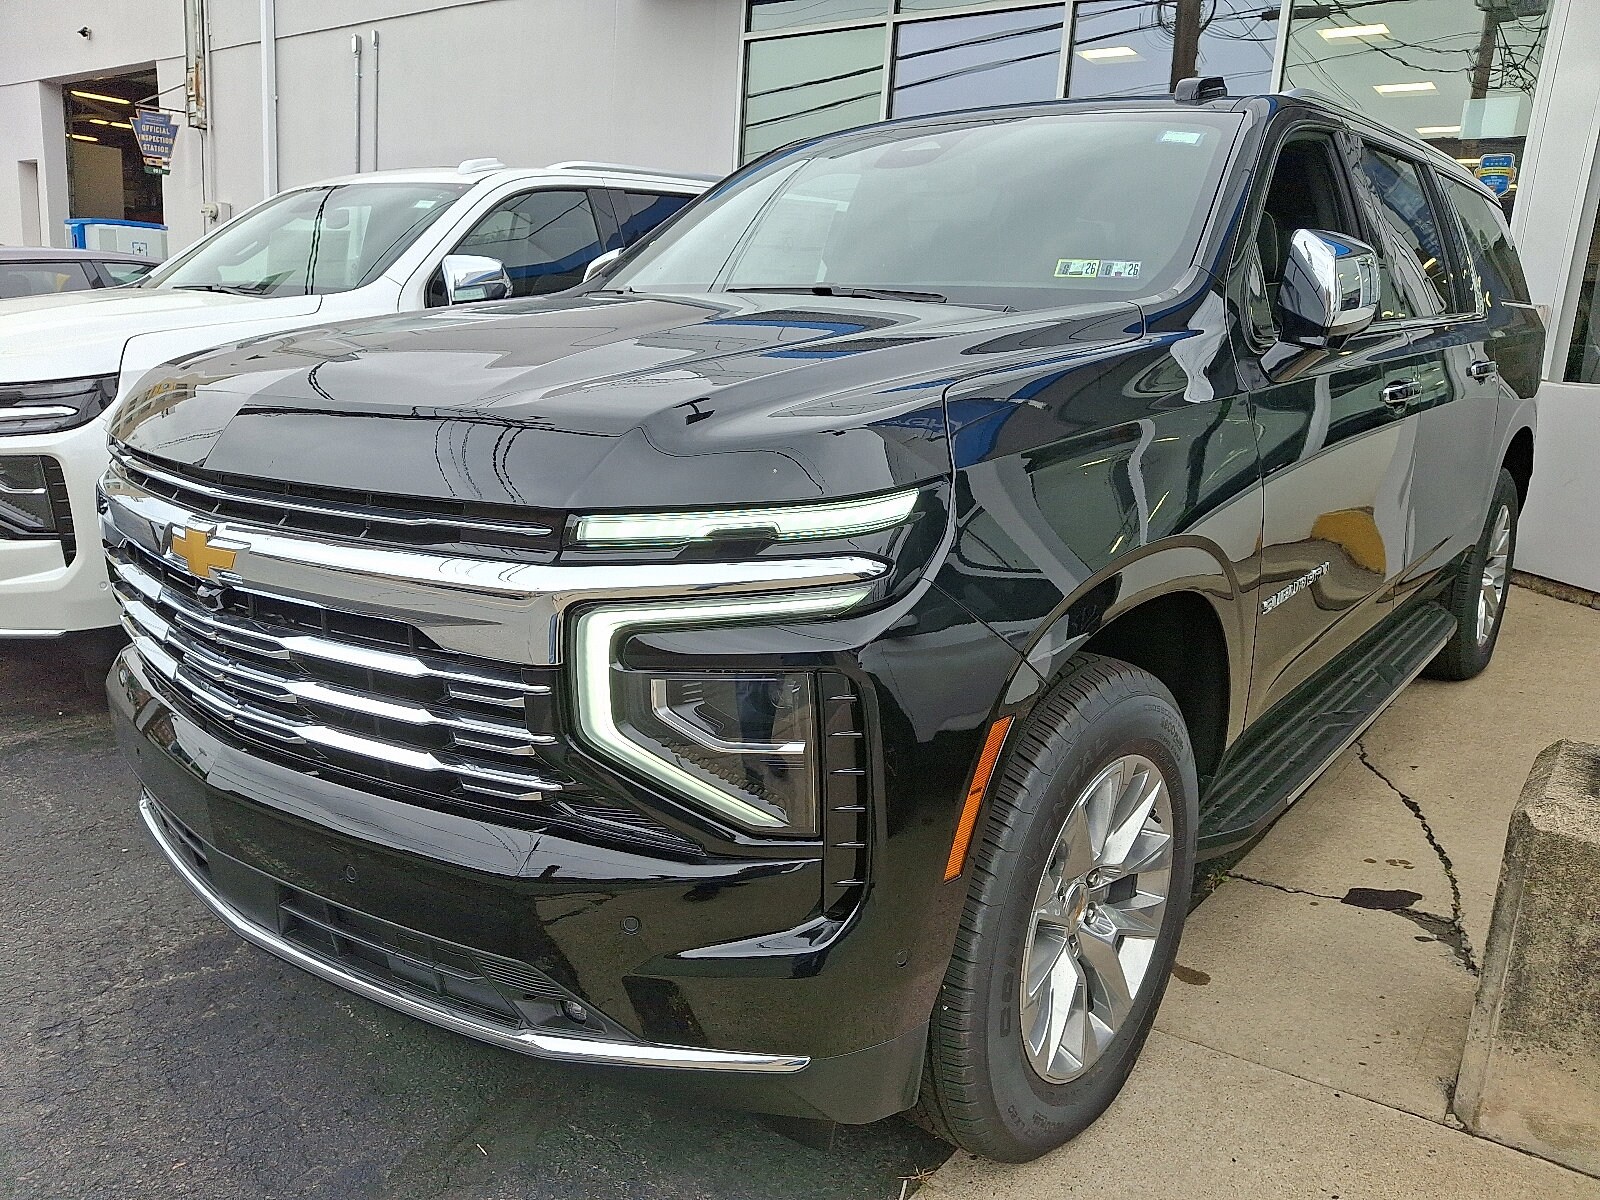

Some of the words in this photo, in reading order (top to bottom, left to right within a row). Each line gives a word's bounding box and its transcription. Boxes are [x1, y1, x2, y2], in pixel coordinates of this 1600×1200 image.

[142, 124, 170, 135] OFFICIAL
[138, 133, 174, 145] INSPECTION
[143, 144, 169, 153] STATION
[1085, 262, 1097, 275] 26
[1128, 263, 1139, 276] 26
